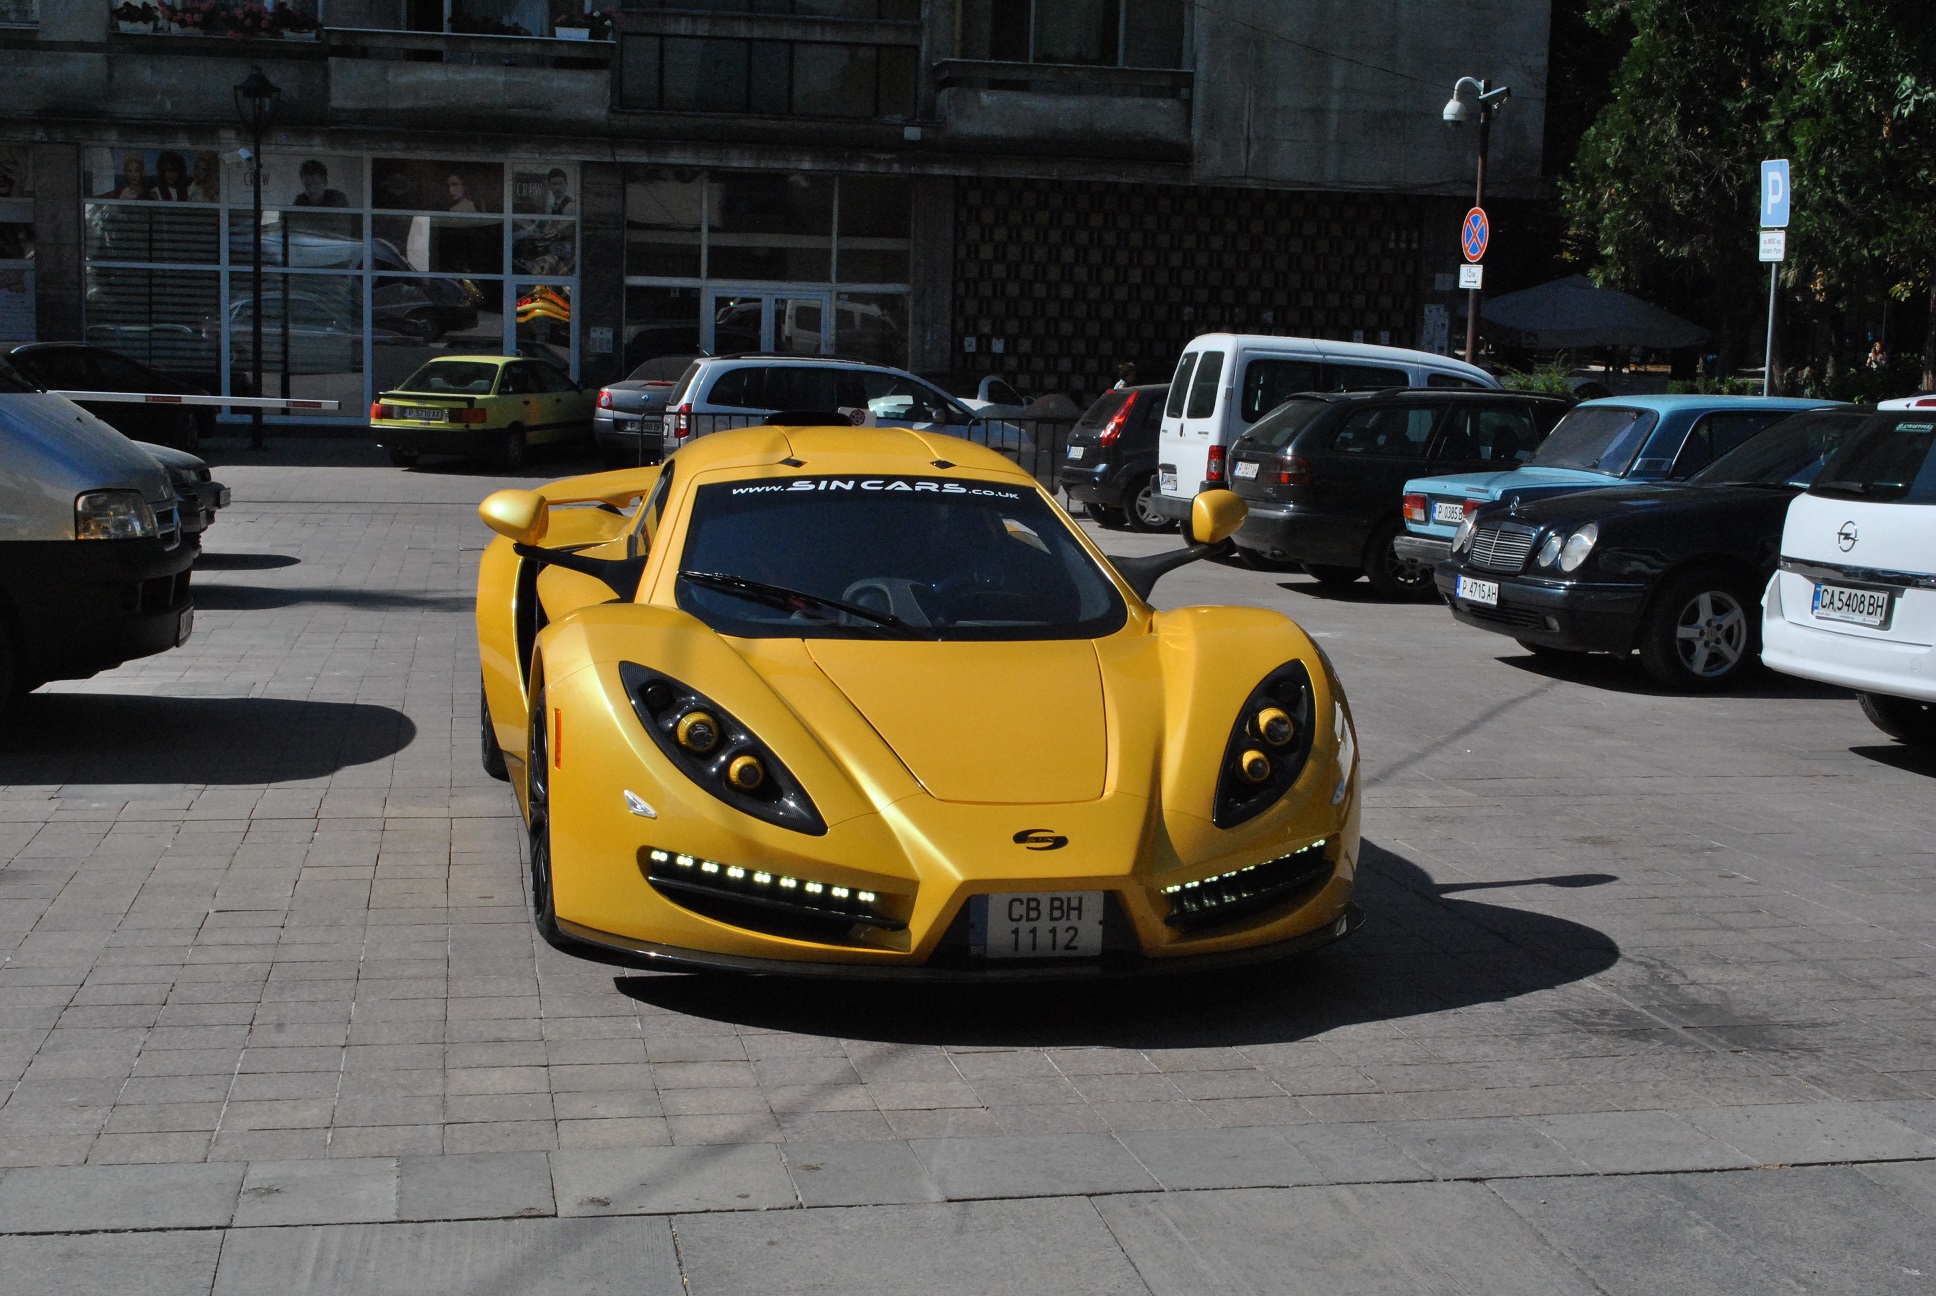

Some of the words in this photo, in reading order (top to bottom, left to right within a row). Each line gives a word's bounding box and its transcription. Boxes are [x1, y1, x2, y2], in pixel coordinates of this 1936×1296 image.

[1767, 172, 1783, 215] P
[1438, 505, 1443, 518] P
[1445, 506, 1458, 520] 0385
[1462, 580, 1467, 595] P
[1469, 581, 1486, 600] 4715
[1487, 585, 1498, 602] AH
[1821, 588, 1835, 610] CA
[1836, 591, 1866, 614] 5408
[1867, 594, 1886, 617] BH
[1007, 897, 1042, 922] CB
[1049, 896, 1083, 922] BH
[1010, 926, 1079, 952] 1112
